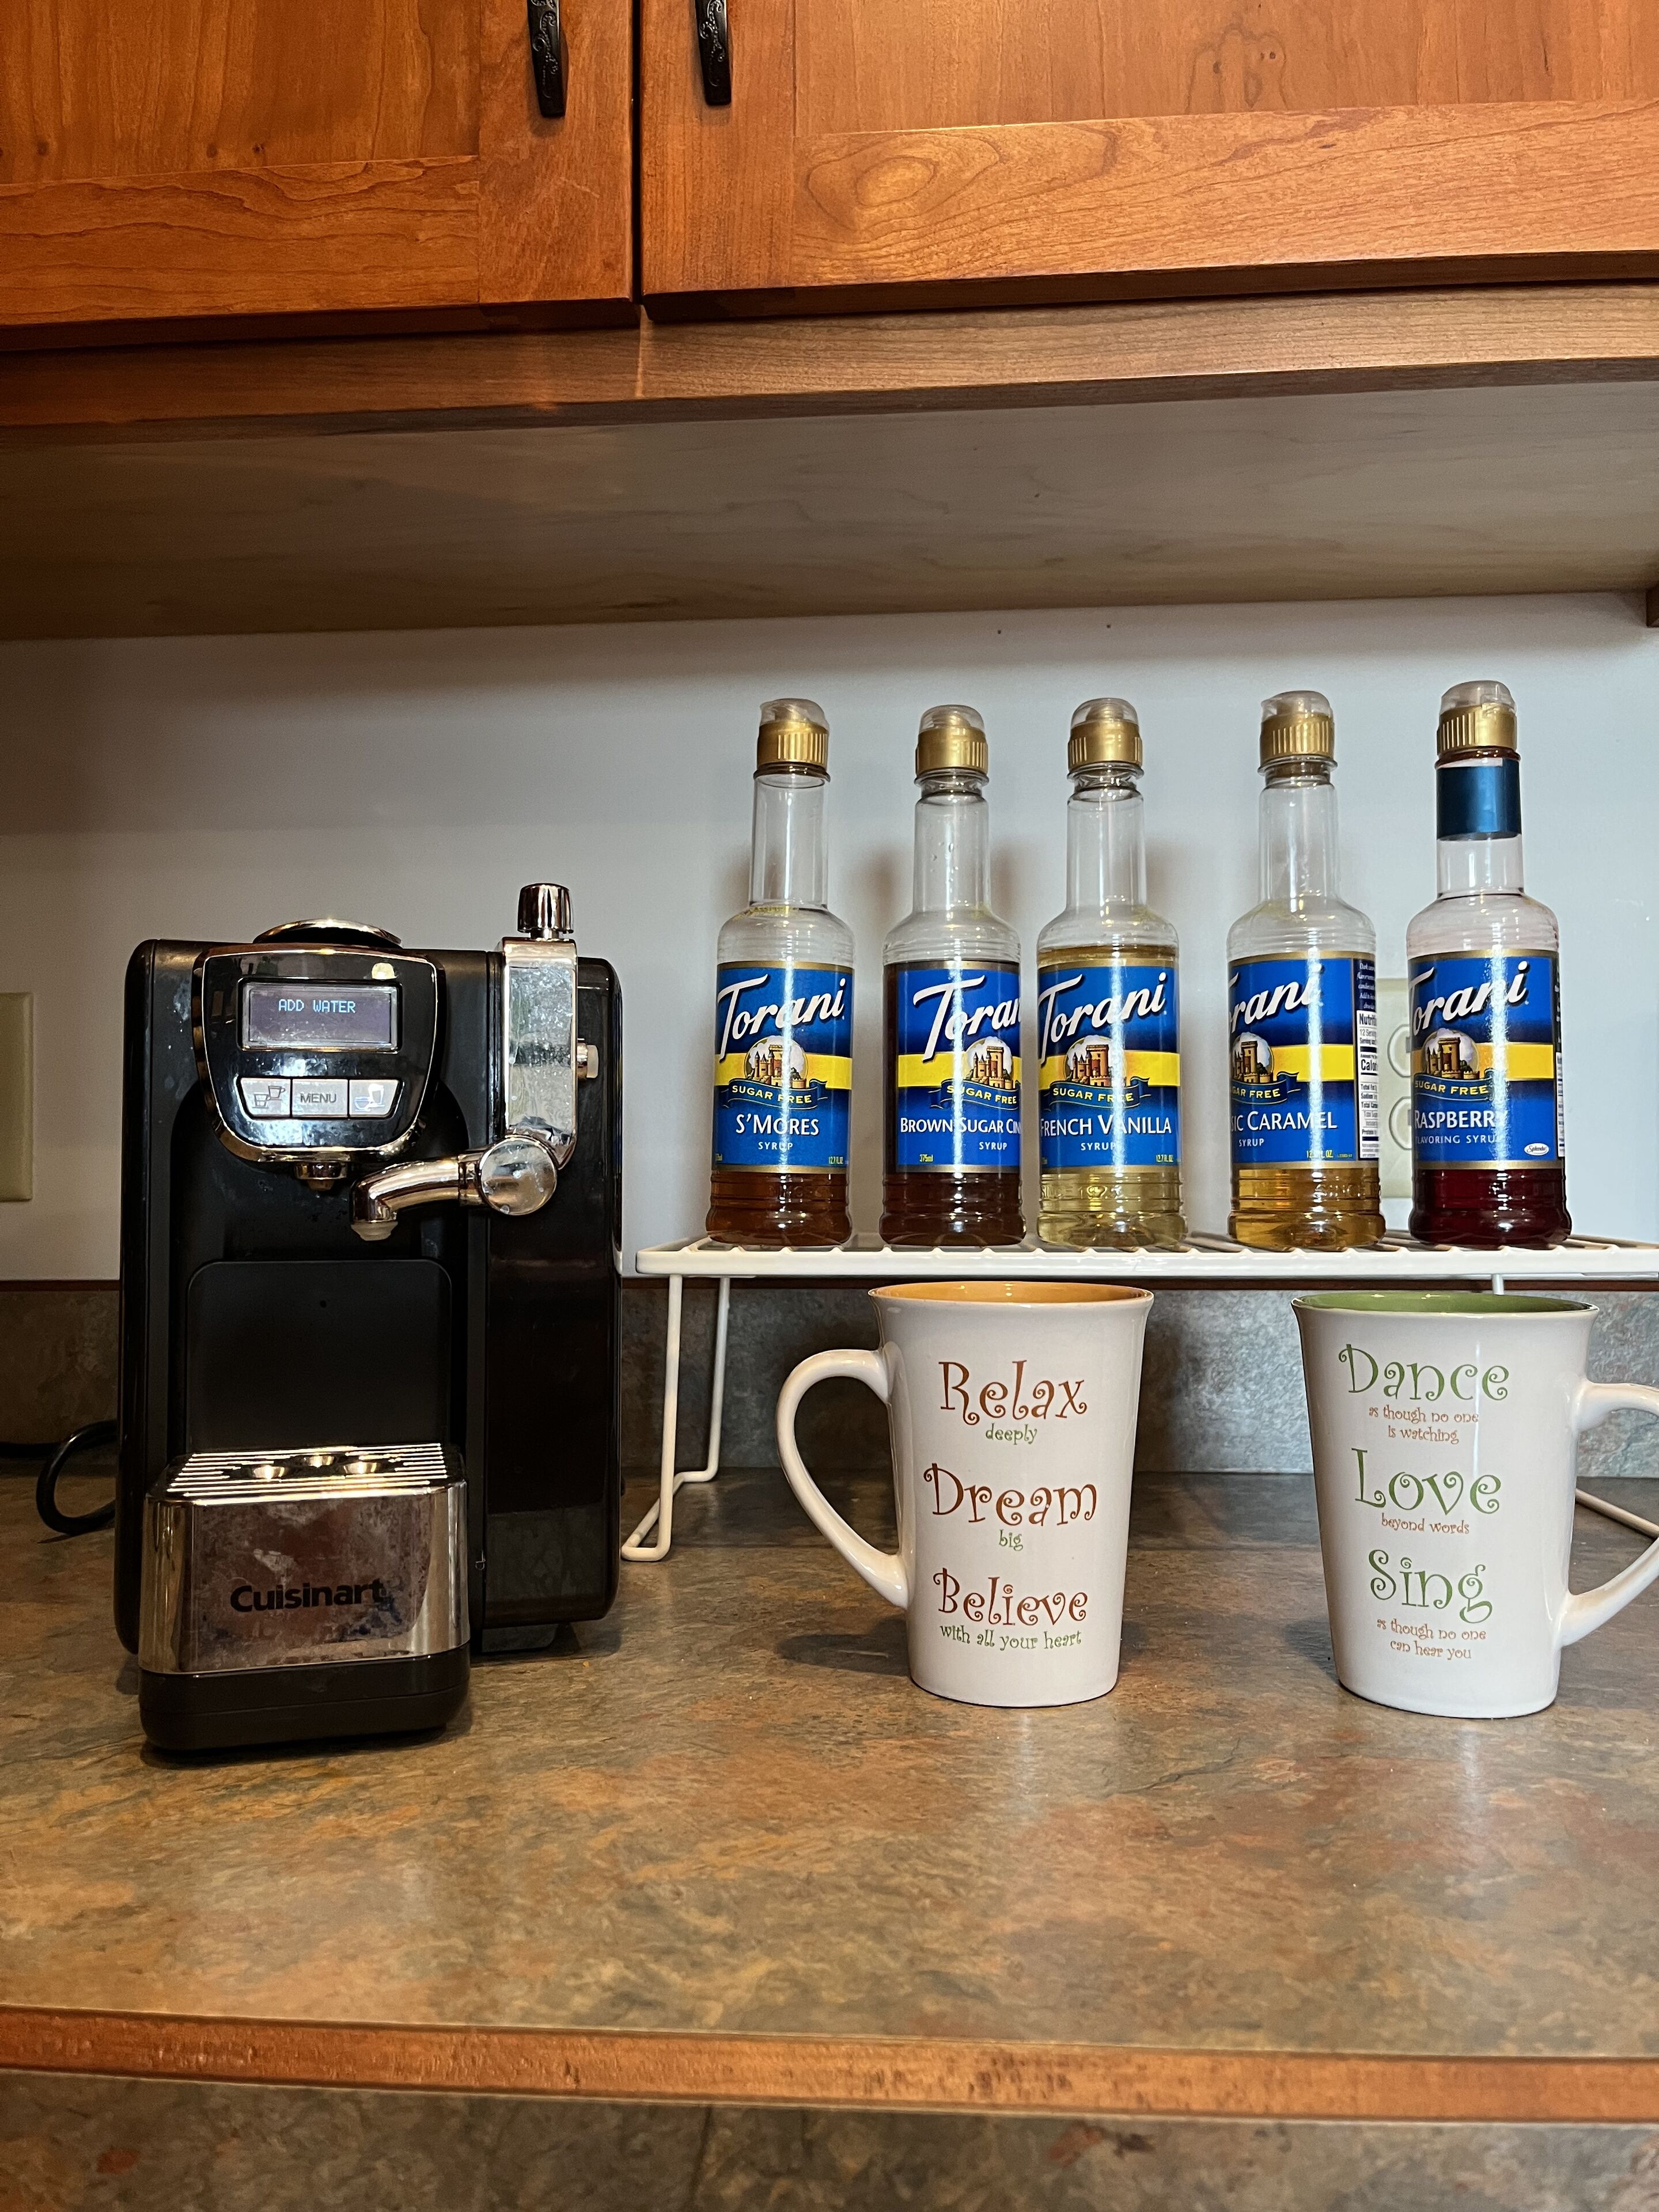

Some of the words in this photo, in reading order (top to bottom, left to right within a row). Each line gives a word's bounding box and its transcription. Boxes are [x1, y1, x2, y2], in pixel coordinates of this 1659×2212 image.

[278, 999, 305, 1012] ADD
[313, 1000, 356, 1014] WATER
[717, 974, 846, 1063] Torani
[1037, 972, 1167, 1066] Torani
[732, 1085, 773, 1100] SUGAR
[778, 1093, 812, 1104] FREE
[1053, 1087, 1093, 1101] SUGAR
[1249, 1088, 1281, 1099] FREE
[1415, 1080, 1446, 1093] SUGAR
[1450, 1085, 1488, 1095] FREE
[300, 1093, 337, 1103] MENU
[995, 1093, 1017, 1105] FREE
[736, 1113, 819, 1136] S'MORES
[900, 1117, 953, 1133] BROWN
[959, 1117, 1003, 1133] SUGAR
[1040, 1118, 1092, 1137] FRENCH
[1247, 1111, 1338, 1130] CARAMEL
[758, 1141, 793, 1151] SYRUP
[979, 1141, 1007, 1150] SYRUP
[1081, 1142, 1118, 1151] SYRUP
[1238, 1138, 1264, 1147] SYRUP
[1466, 1135, 1502, 1144] SYRU
[1338, 1344, 1510, 1402] Dance
[938, 1360, 1088, 1426] Relax
[1369, 1406, 1379, 1418] as
[1382, 1404, 1426, 1423] though
[1431, 1412, 1449, 1423] no
[1453, 1412, 1479, 1423] one
[986, 1422, 1038, 1445] deeply
[1388, 1426, 1396, 1438] is
[1399, 1427, 1459, 1445] watching
[1351, 1447, 1502, 1516] Love
[923, 1463, 1097, 1527] Dream
[1381, 1513, 1425, 1532] beyond
[1430, 1521, 1470, 1535] words
[998, 1529, 1024, 1551] big
[230, 1578, 384, 1612] Cuisinart
[1368, 1548, 1493, 1624] Sing
[933, 1567, 1088, 1627] Believe
[940, 1623, 971, 1645] with
[977, 1628, 995, 1647] all
[1000, 1634, 1038, 1651] your
[1044, 1630, 1082, 1650] heart
[1377, 1618, 1387, 1630] as
[1390, 1618, 1434, 1640] though
[1438, 1628, 1456, 1640] no
[1461, 1629, 1487, 1641] one
[1390, 1639, 1411, 1653] can
[1415, 1640, 1444, 1657] hear
[1447, 1647, 1472, 1661] you
